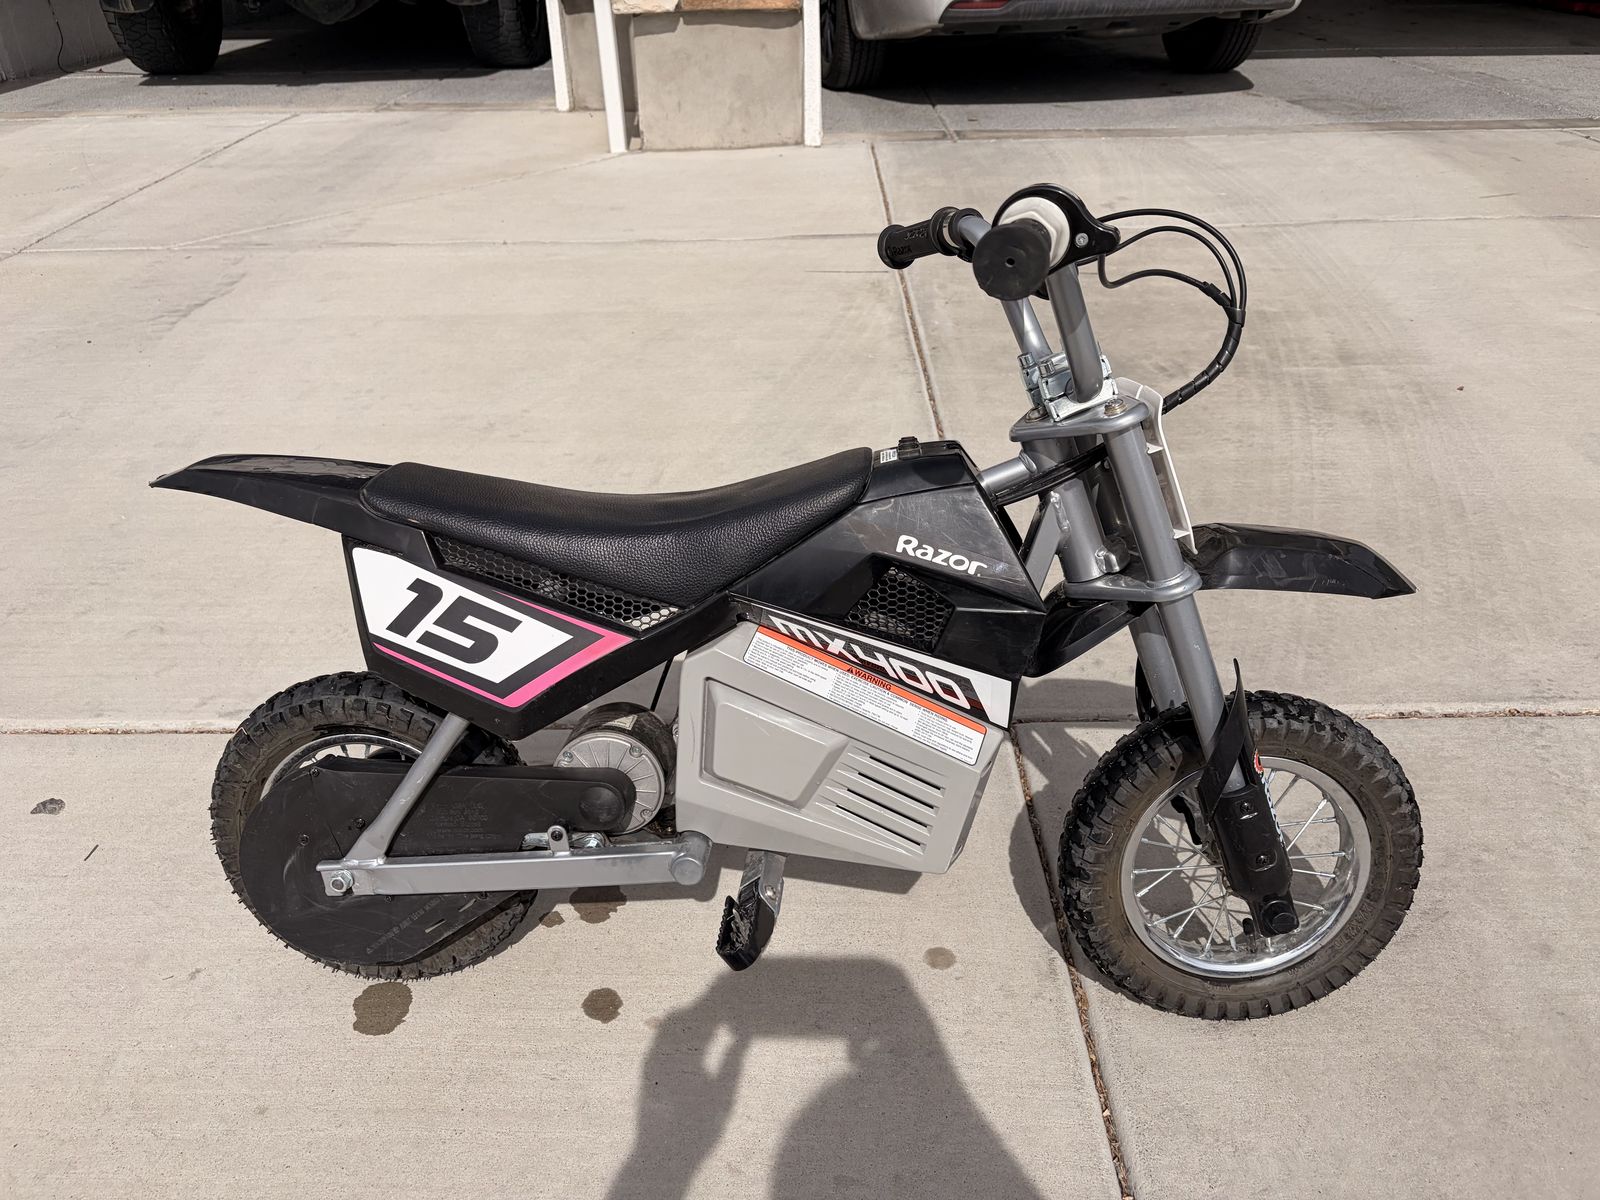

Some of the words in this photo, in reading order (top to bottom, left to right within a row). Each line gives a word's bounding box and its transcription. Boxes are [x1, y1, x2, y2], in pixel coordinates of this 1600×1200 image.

[896, 534, 987, 575] Razor
[386, 578, 522, 664] 15
[769, 615, 971, 709] MX400
[795, 650, 813, 660] PRODUCT
[850, 676, 868, 686] EXERCISE
[869, 684, 886, 694] CAUTION
[889, 693, 908, 703] COMMON
[853, 667, 893, 691] WARNING
